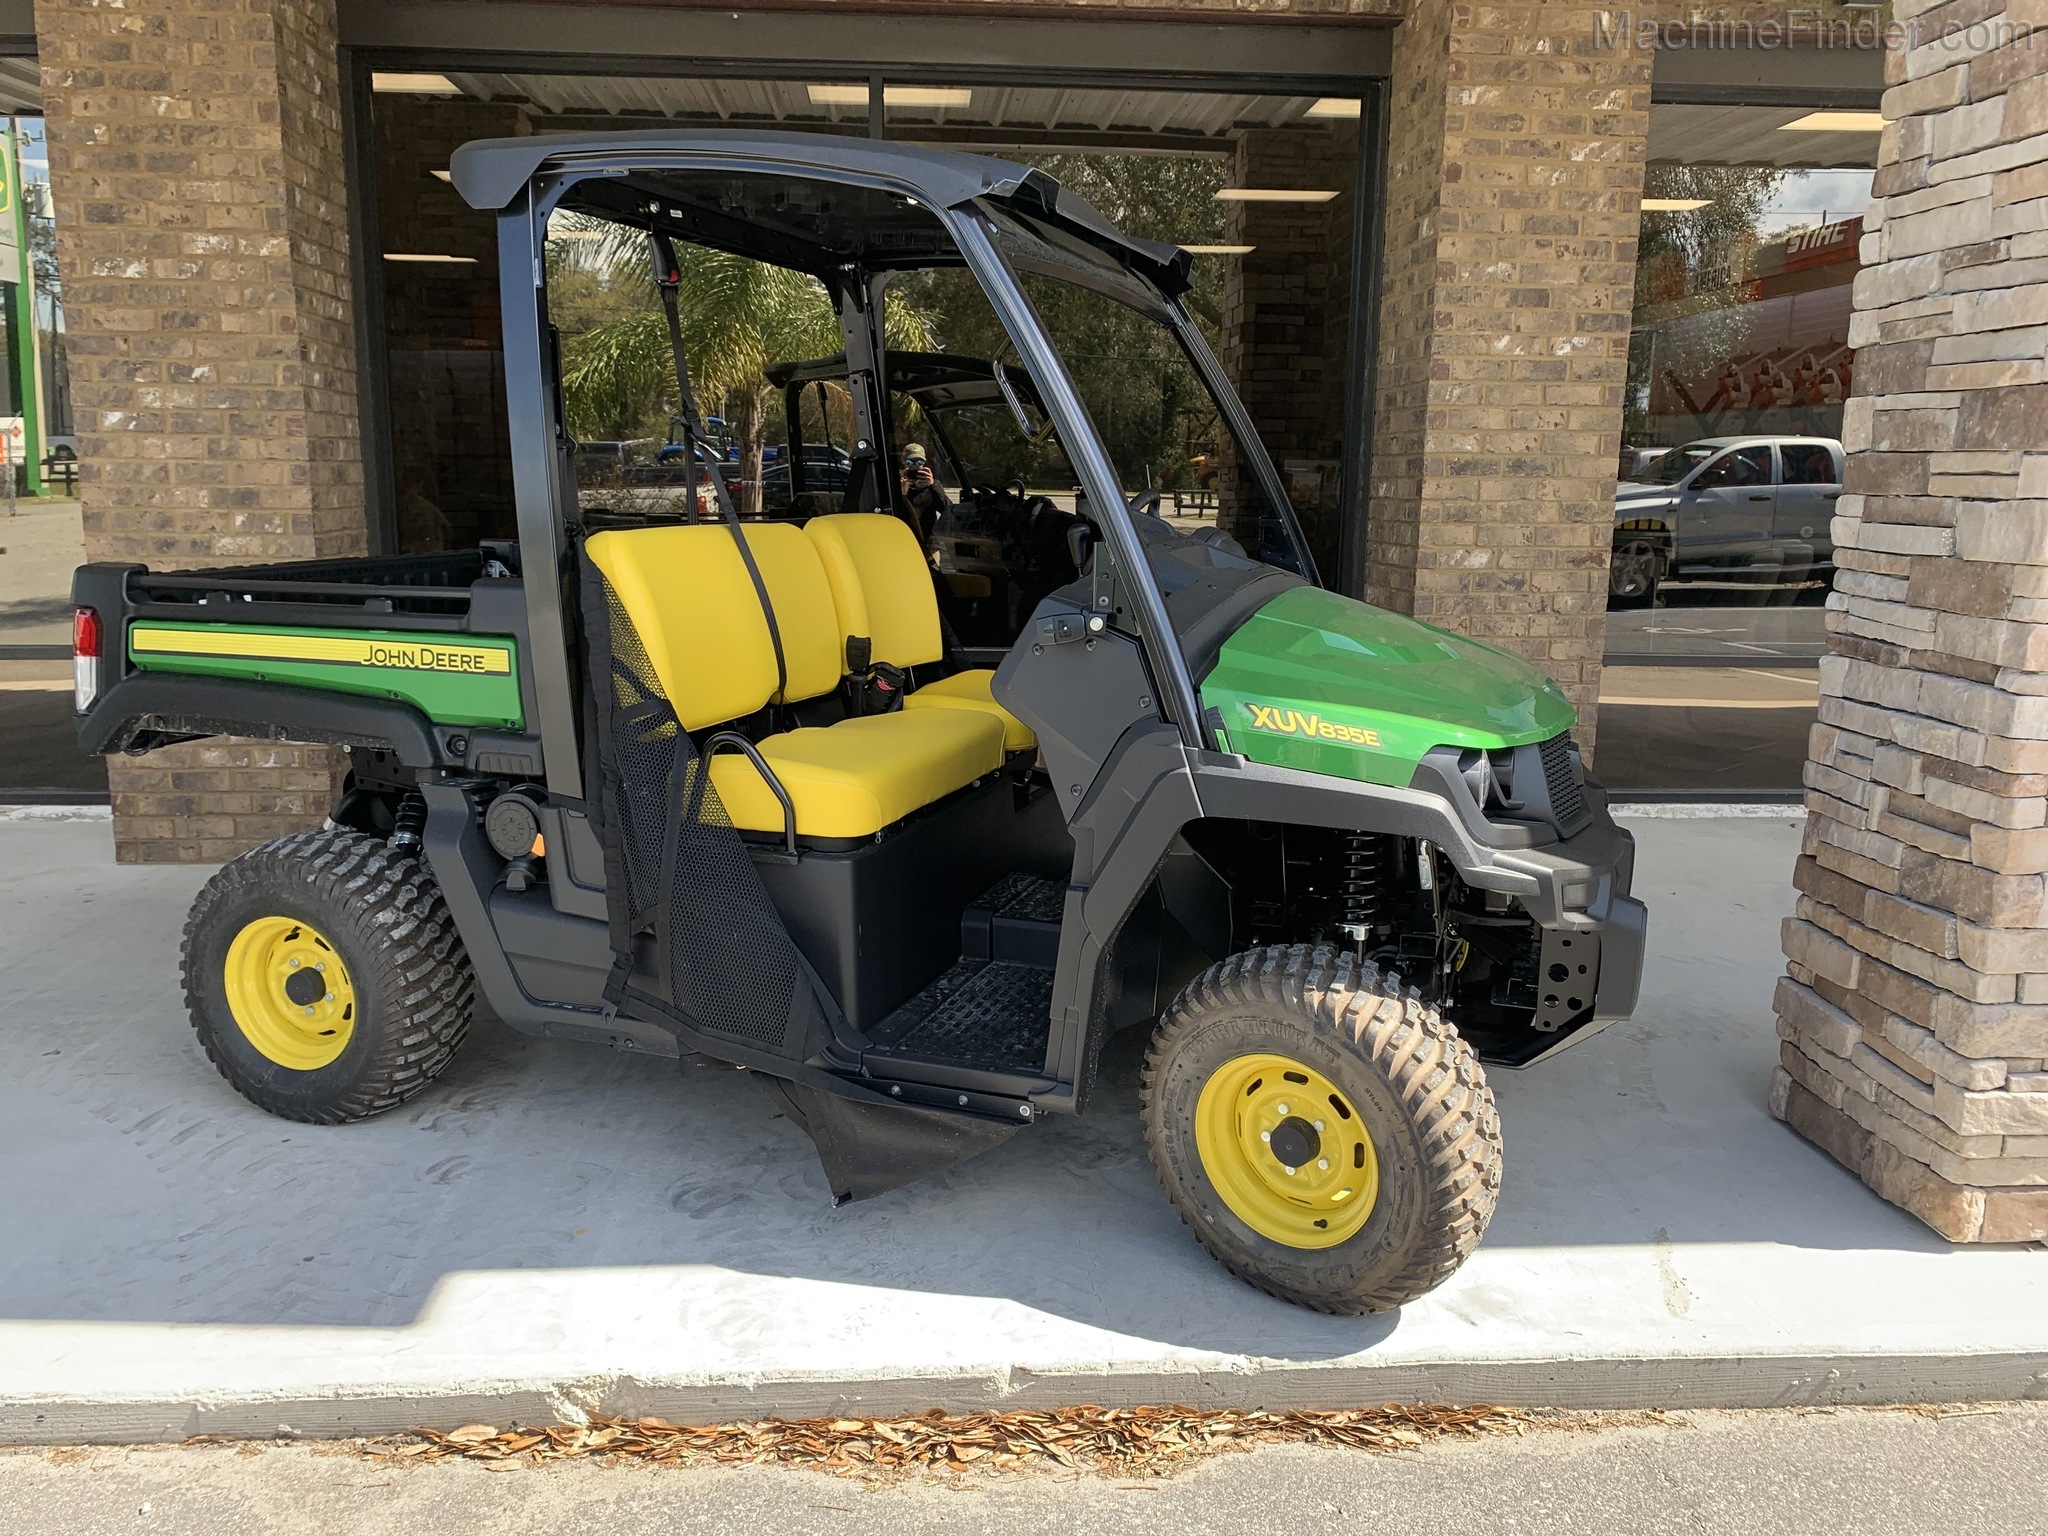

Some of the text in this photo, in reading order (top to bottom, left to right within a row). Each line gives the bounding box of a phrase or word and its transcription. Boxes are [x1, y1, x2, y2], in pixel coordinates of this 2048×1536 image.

[363, 645, 485, 670] JOHN DEERE
[1247, 703, 1382, 748] XUV835E
